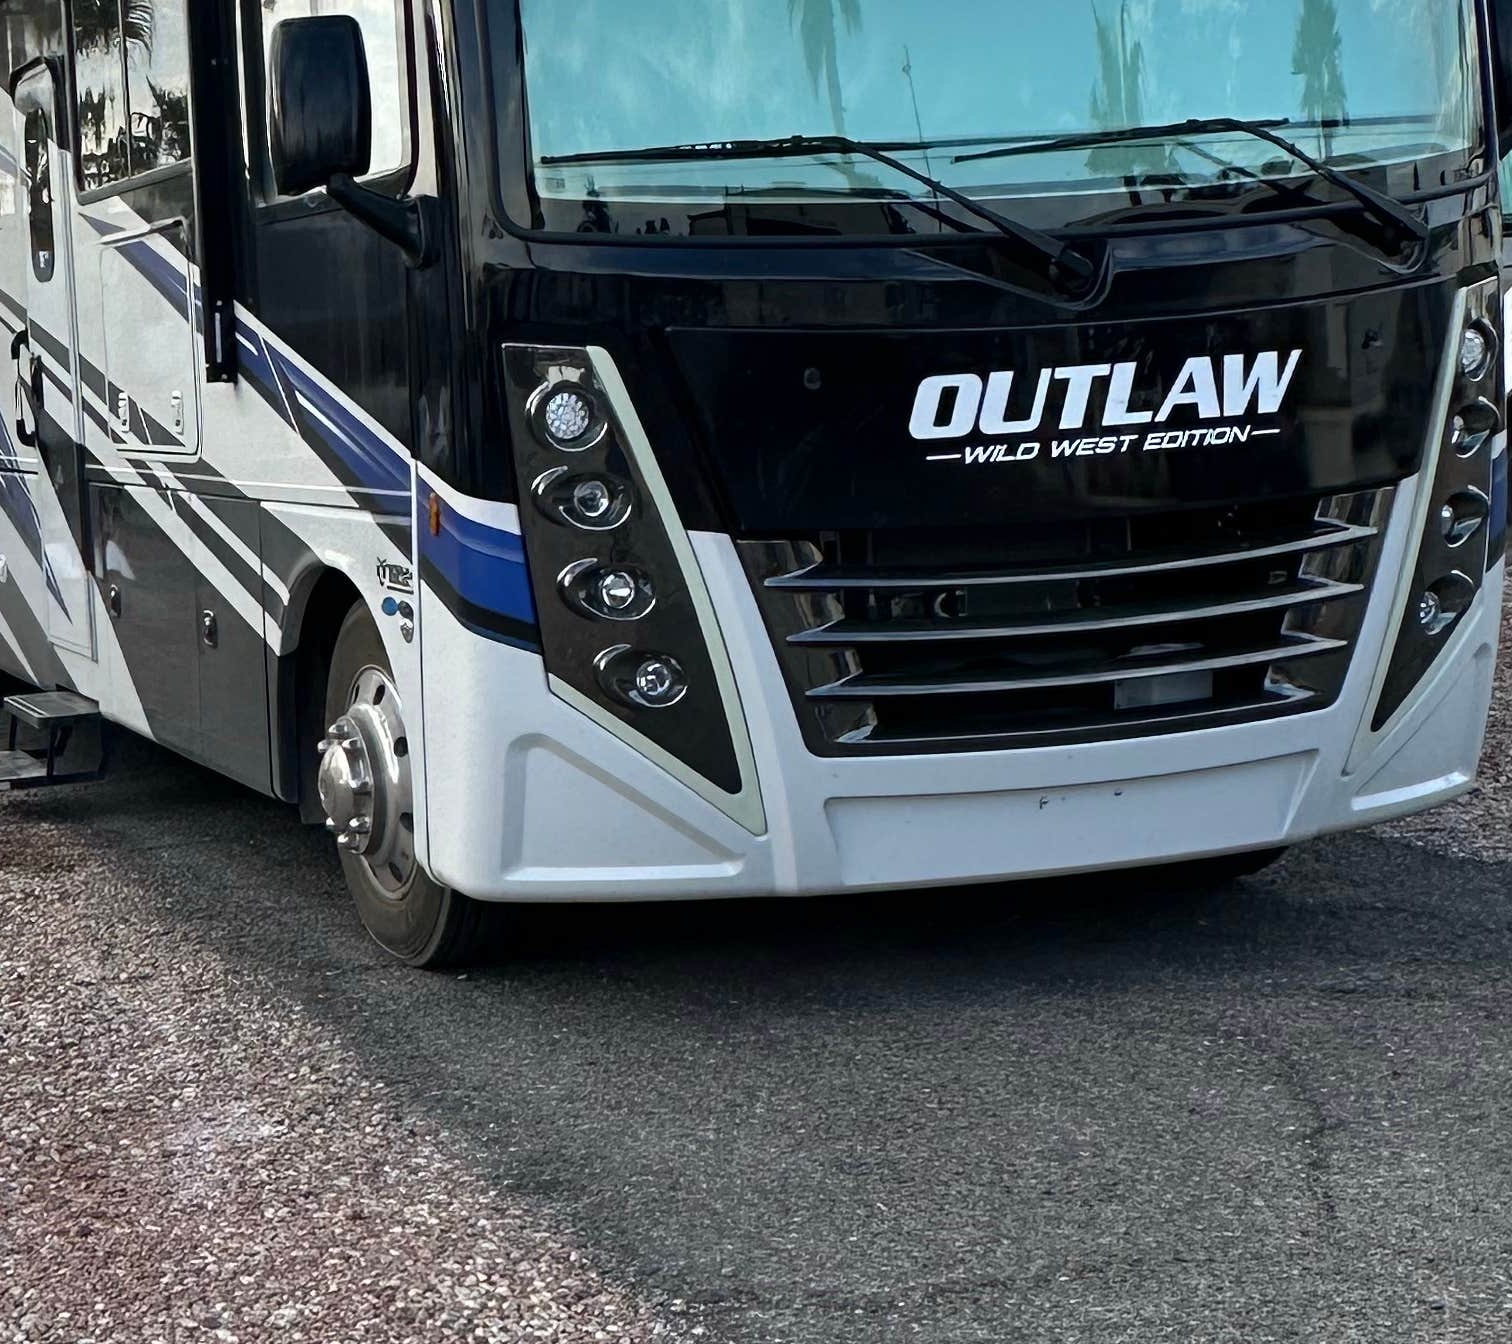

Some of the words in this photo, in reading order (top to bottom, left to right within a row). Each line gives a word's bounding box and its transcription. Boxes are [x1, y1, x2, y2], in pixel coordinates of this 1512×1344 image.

[908, 348, 1303, 440] OUTLAW
[964, 442, 1040, 464] WILD
[1051, 434, 1139, 458] WEST
[1143, 424, 1251, 451] EDITION
